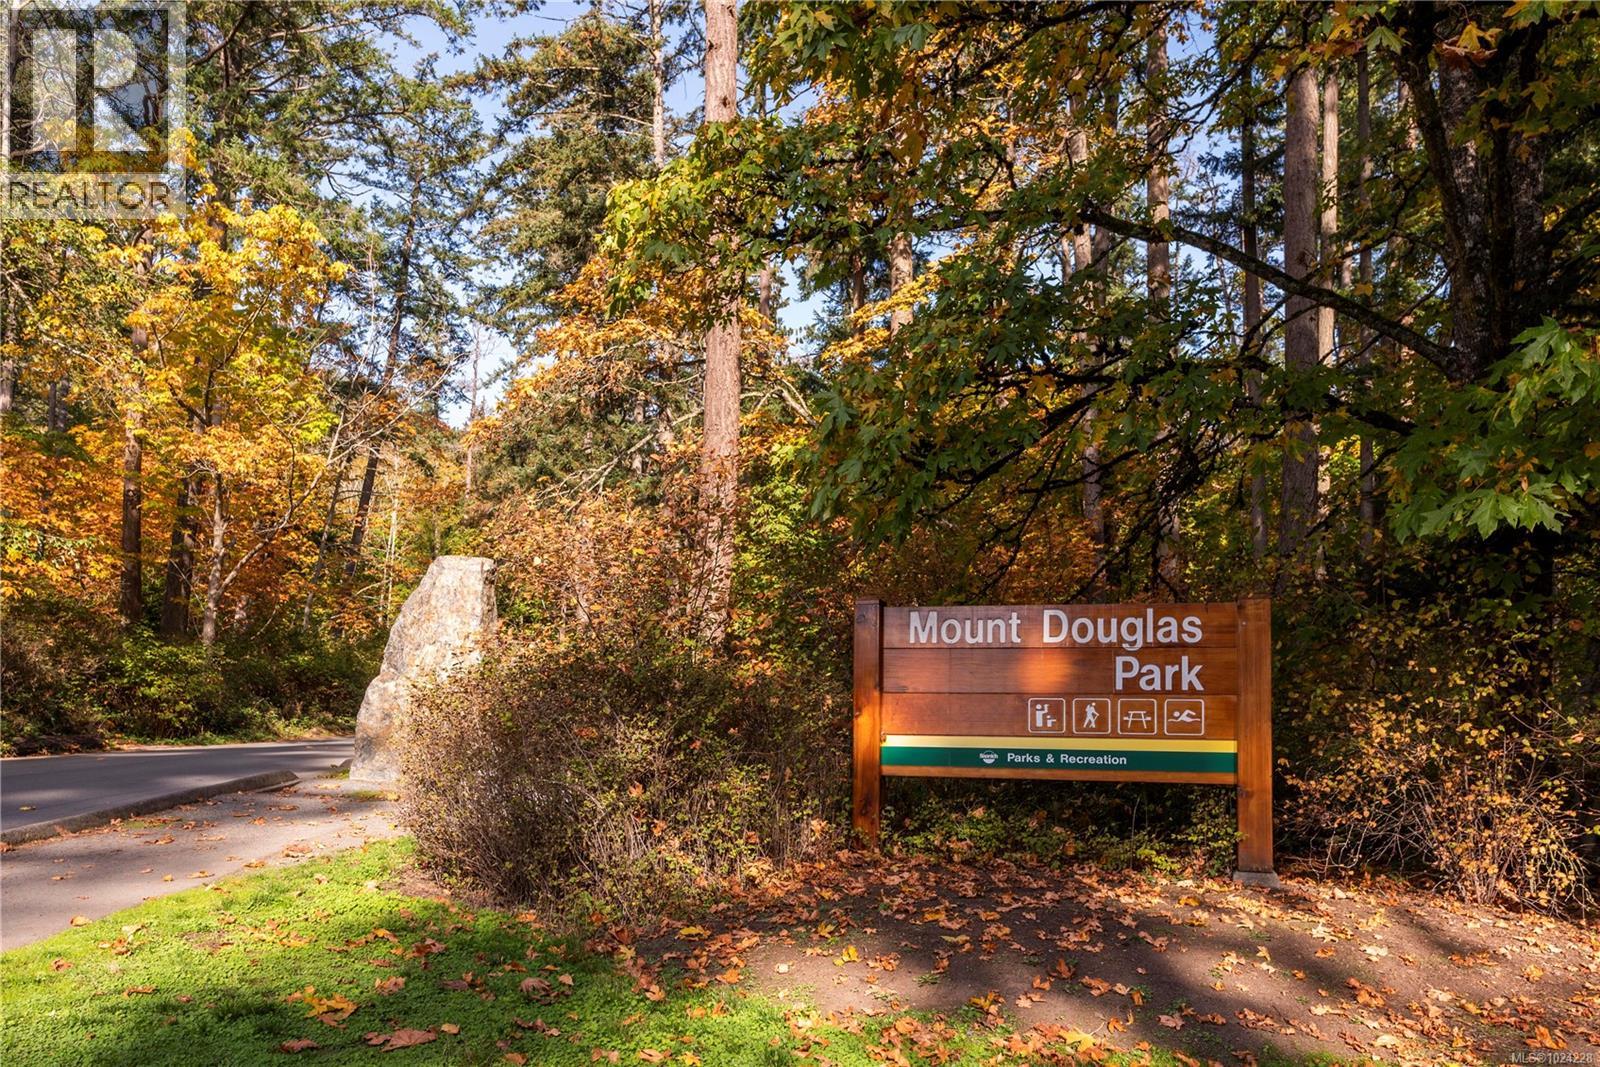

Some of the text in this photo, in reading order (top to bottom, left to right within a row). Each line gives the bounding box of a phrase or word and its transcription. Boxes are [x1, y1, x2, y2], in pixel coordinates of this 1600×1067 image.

[909, 608, 1203, 651] Mount Douglas
[1115, 656, 1204, 691] Park
[1007, 753, 1040, 763] Parks
[1046, 754, 1054, 763] &
[1060, 754, 1127, 765] Recreation
